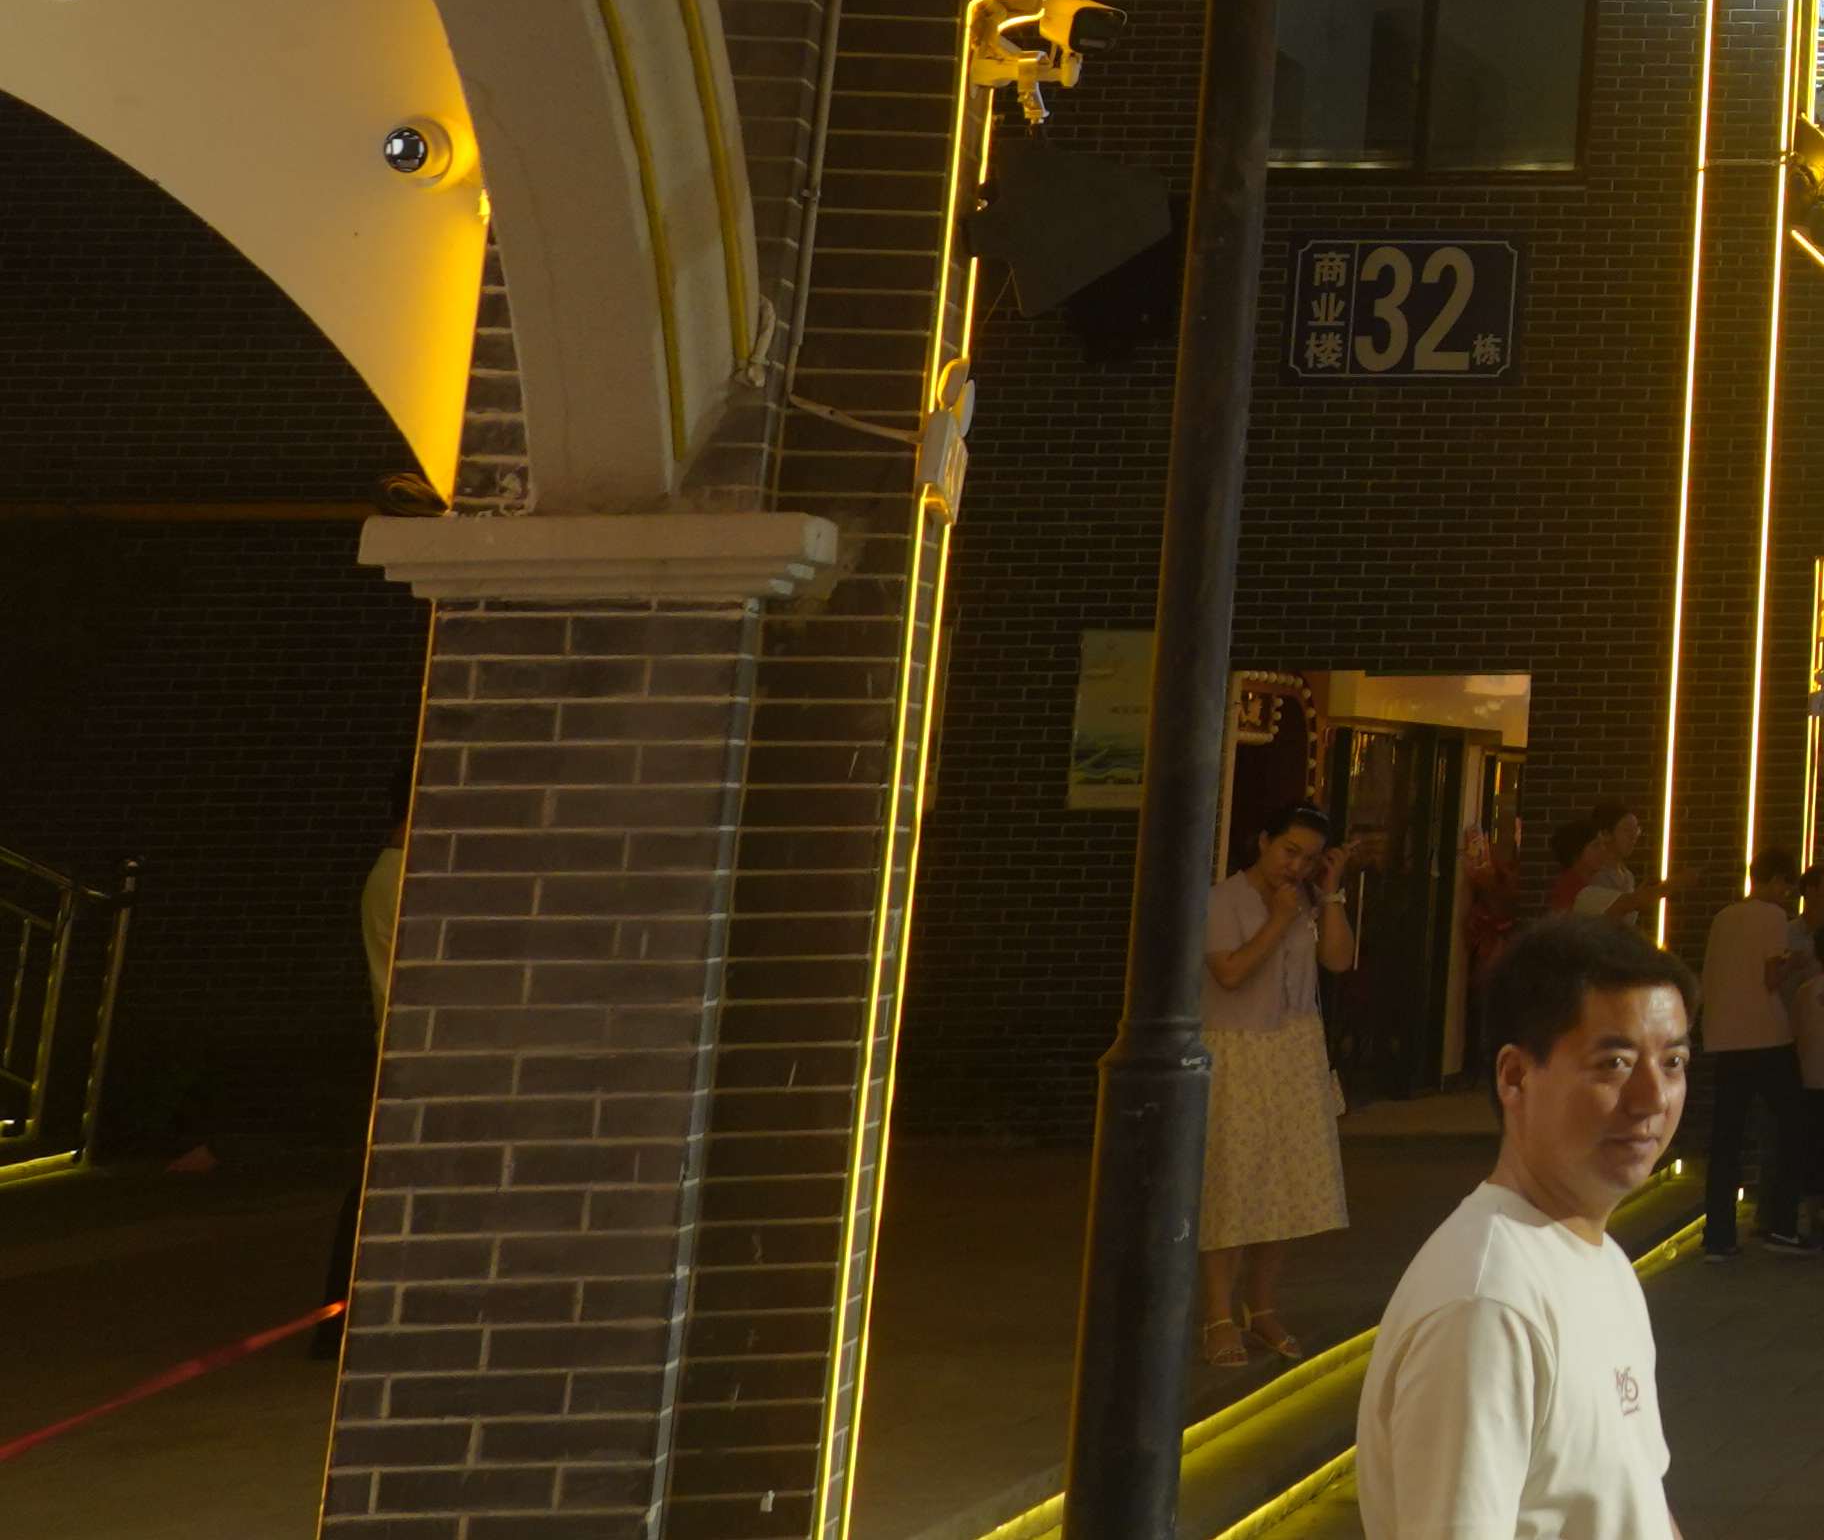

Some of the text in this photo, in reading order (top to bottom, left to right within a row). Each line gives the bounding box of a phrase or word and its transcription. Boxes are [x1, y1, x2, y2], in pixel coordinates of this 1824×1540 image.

[1305, 252, 1348, 369] 商业楼
[1355, 246, 1475, 373] 32
[1473, 334, 1502, 365] 栋
